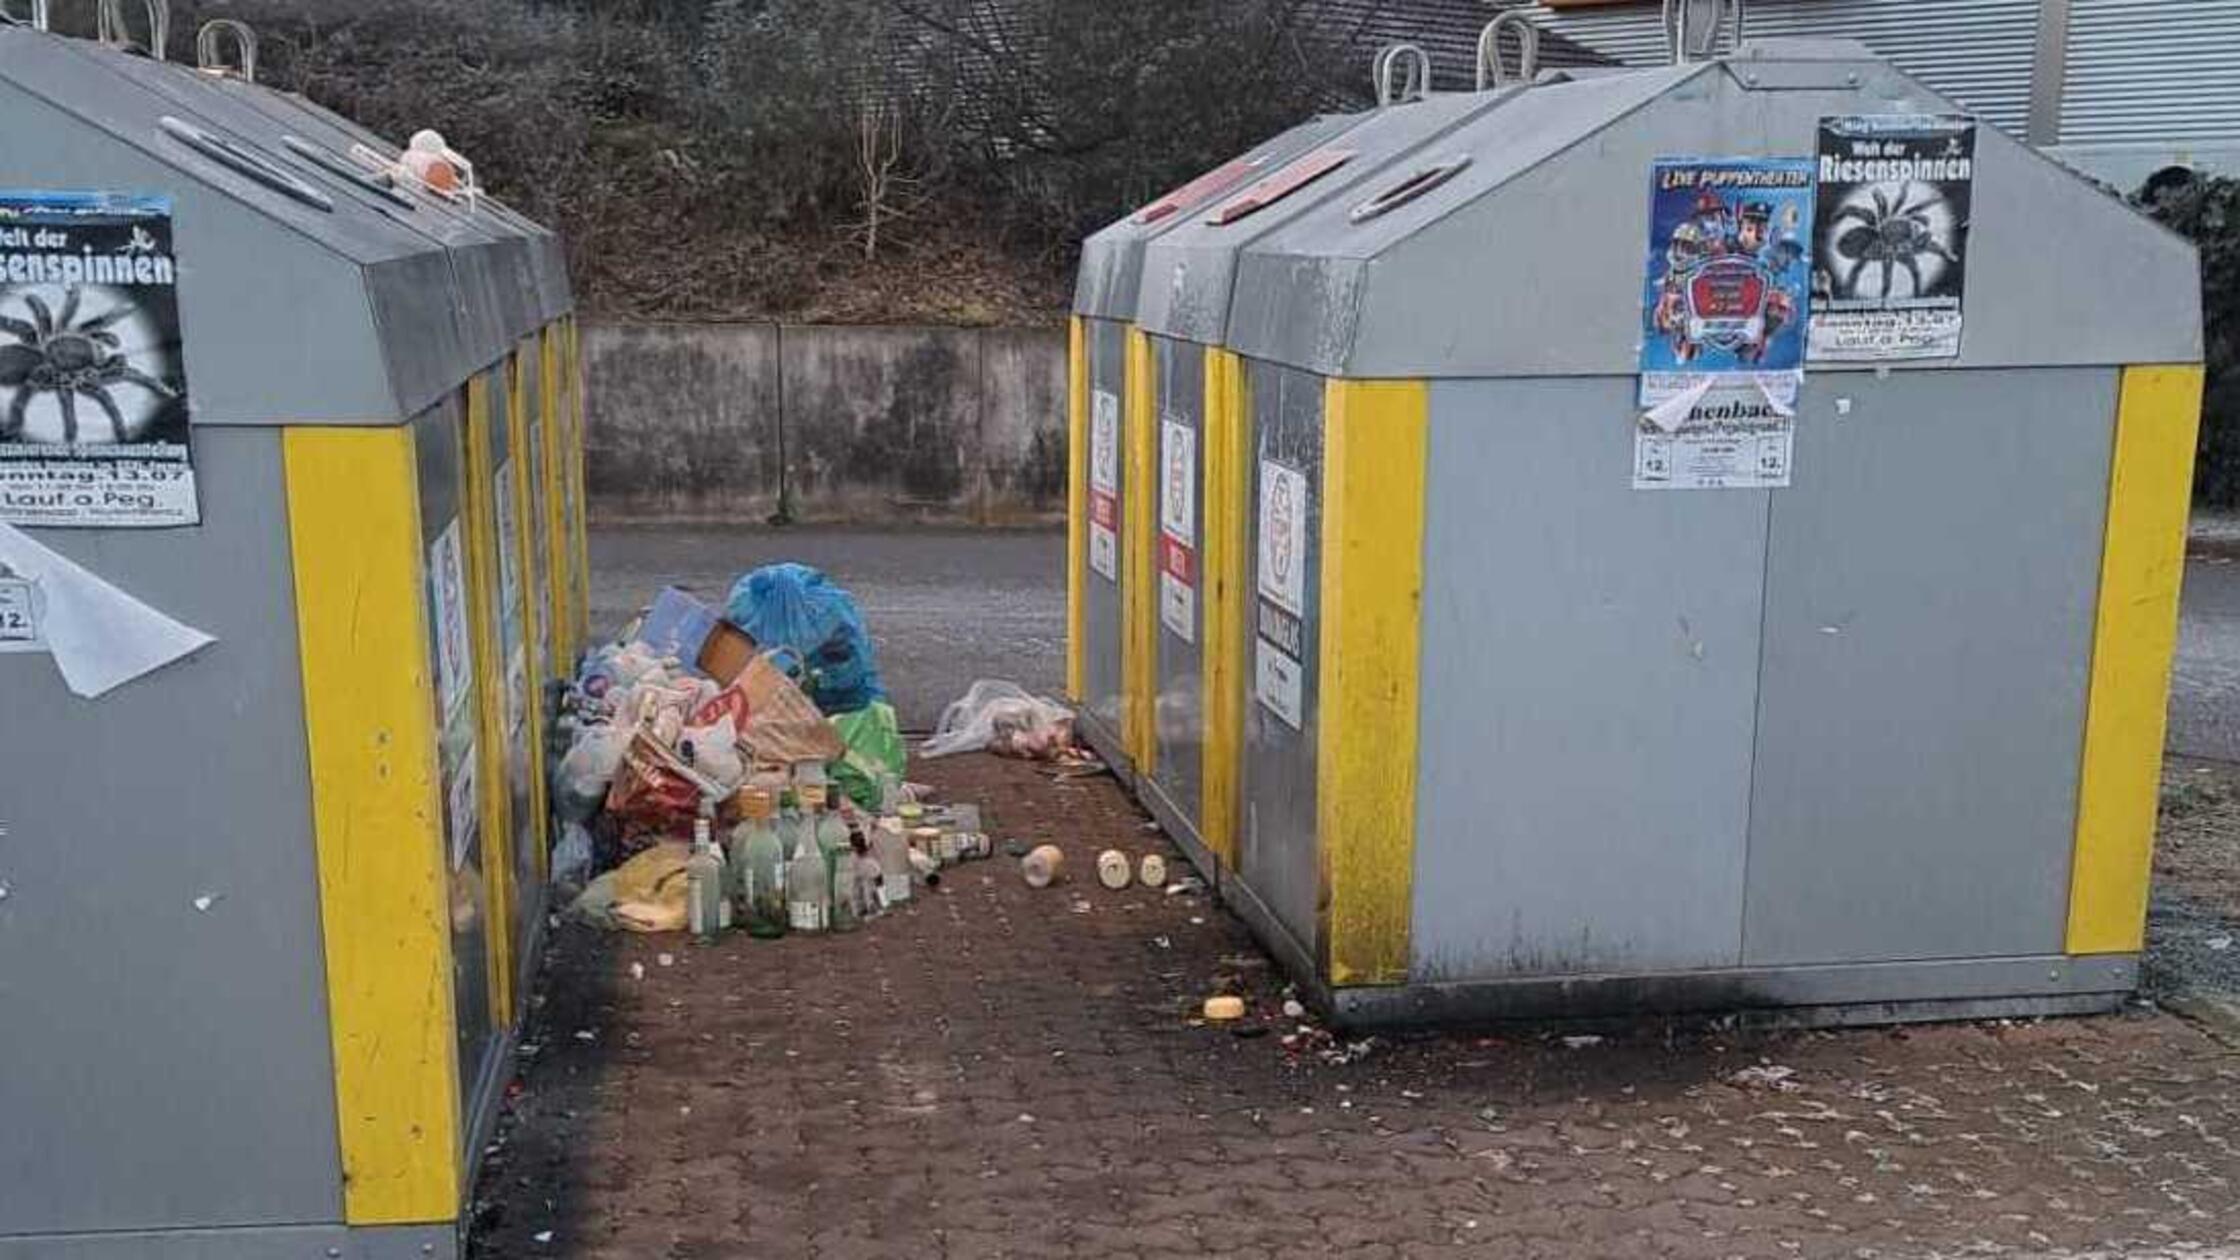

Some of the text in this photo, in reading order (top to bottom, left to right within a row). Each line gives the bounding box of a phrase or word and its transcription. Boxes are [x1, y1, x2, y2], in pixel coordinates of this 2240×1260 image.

[1819, 152, 1971, 184] Riesenspinnen
[0, 227, 68, 248] elt der
